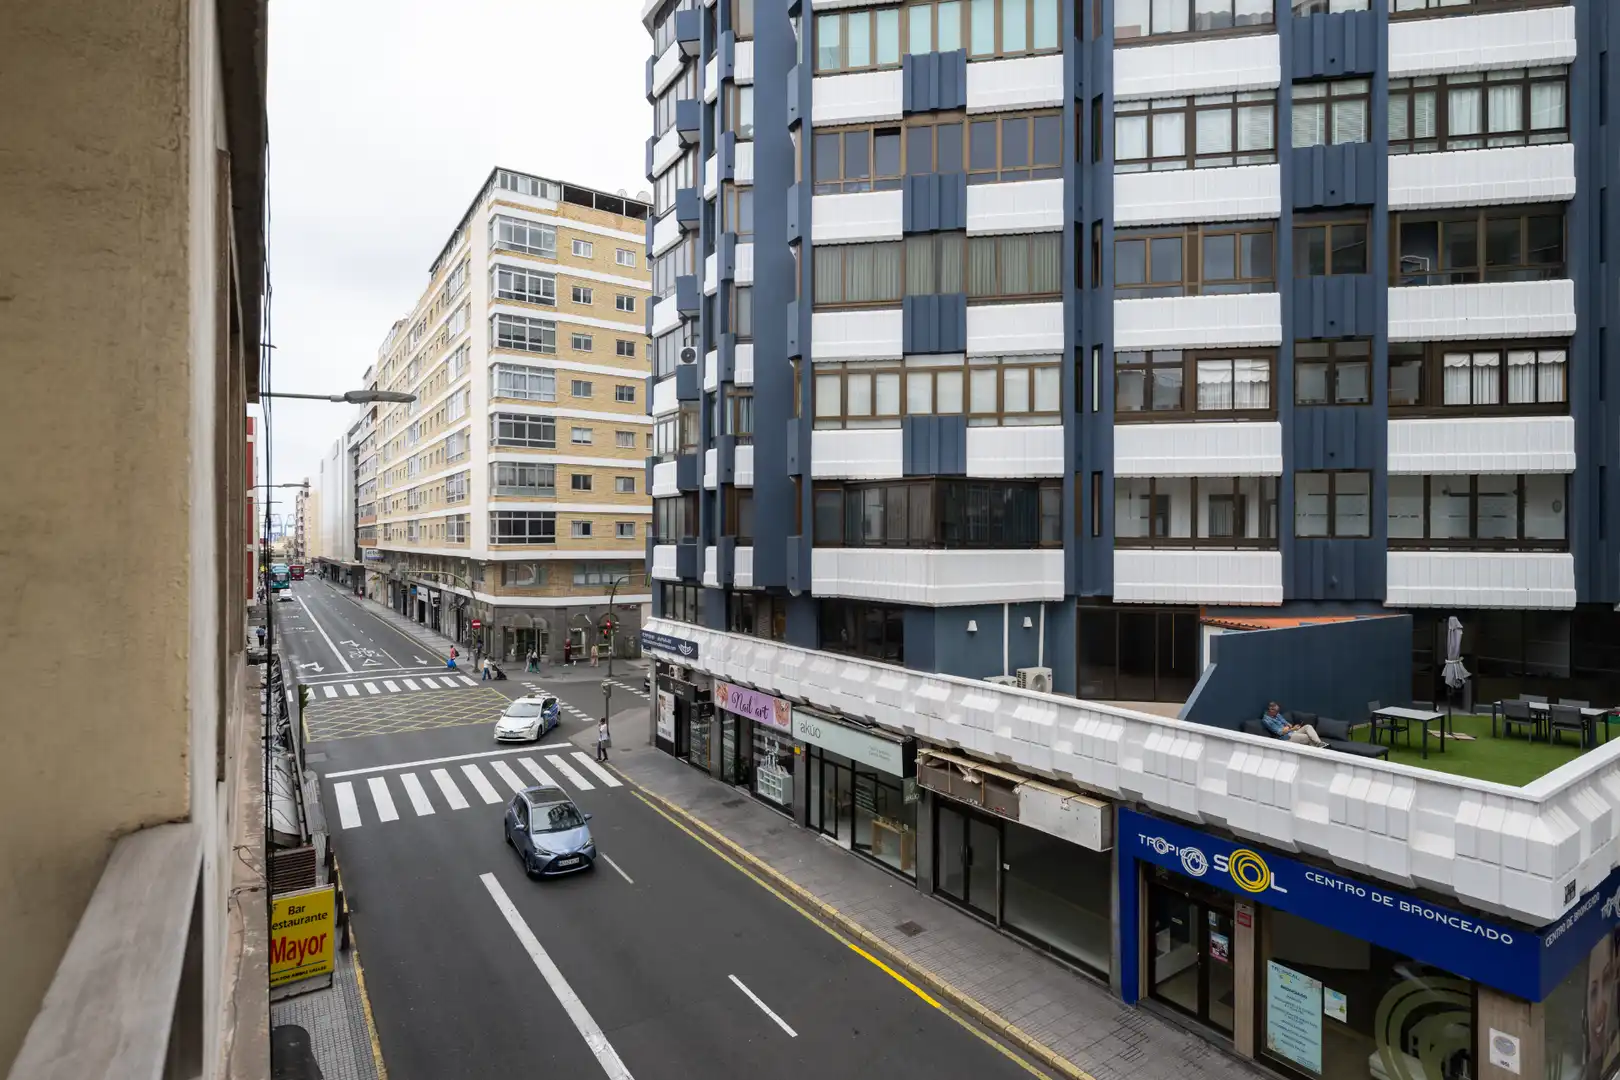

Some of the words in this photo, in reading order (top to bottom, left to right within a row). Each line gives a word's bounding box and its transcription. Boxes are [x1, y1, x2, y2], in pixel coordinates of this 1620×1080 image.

[731, 691, 753, 714] Nail
[755, 704, 769, 720] art
[1213, 848, 1287, 894] SOL
[271, 911, 328, 930] estaurante
[288, 905, 306, 916] Bar
[1305, 871, 1366, 898] CENTRO
[1372, 891, 1394, 908] DE
[1399, 901, 1514, 946] BRONCEADO
[270, 933, 327, 966] Mayor
[1545, 922, 1566, 948] CENTRO
